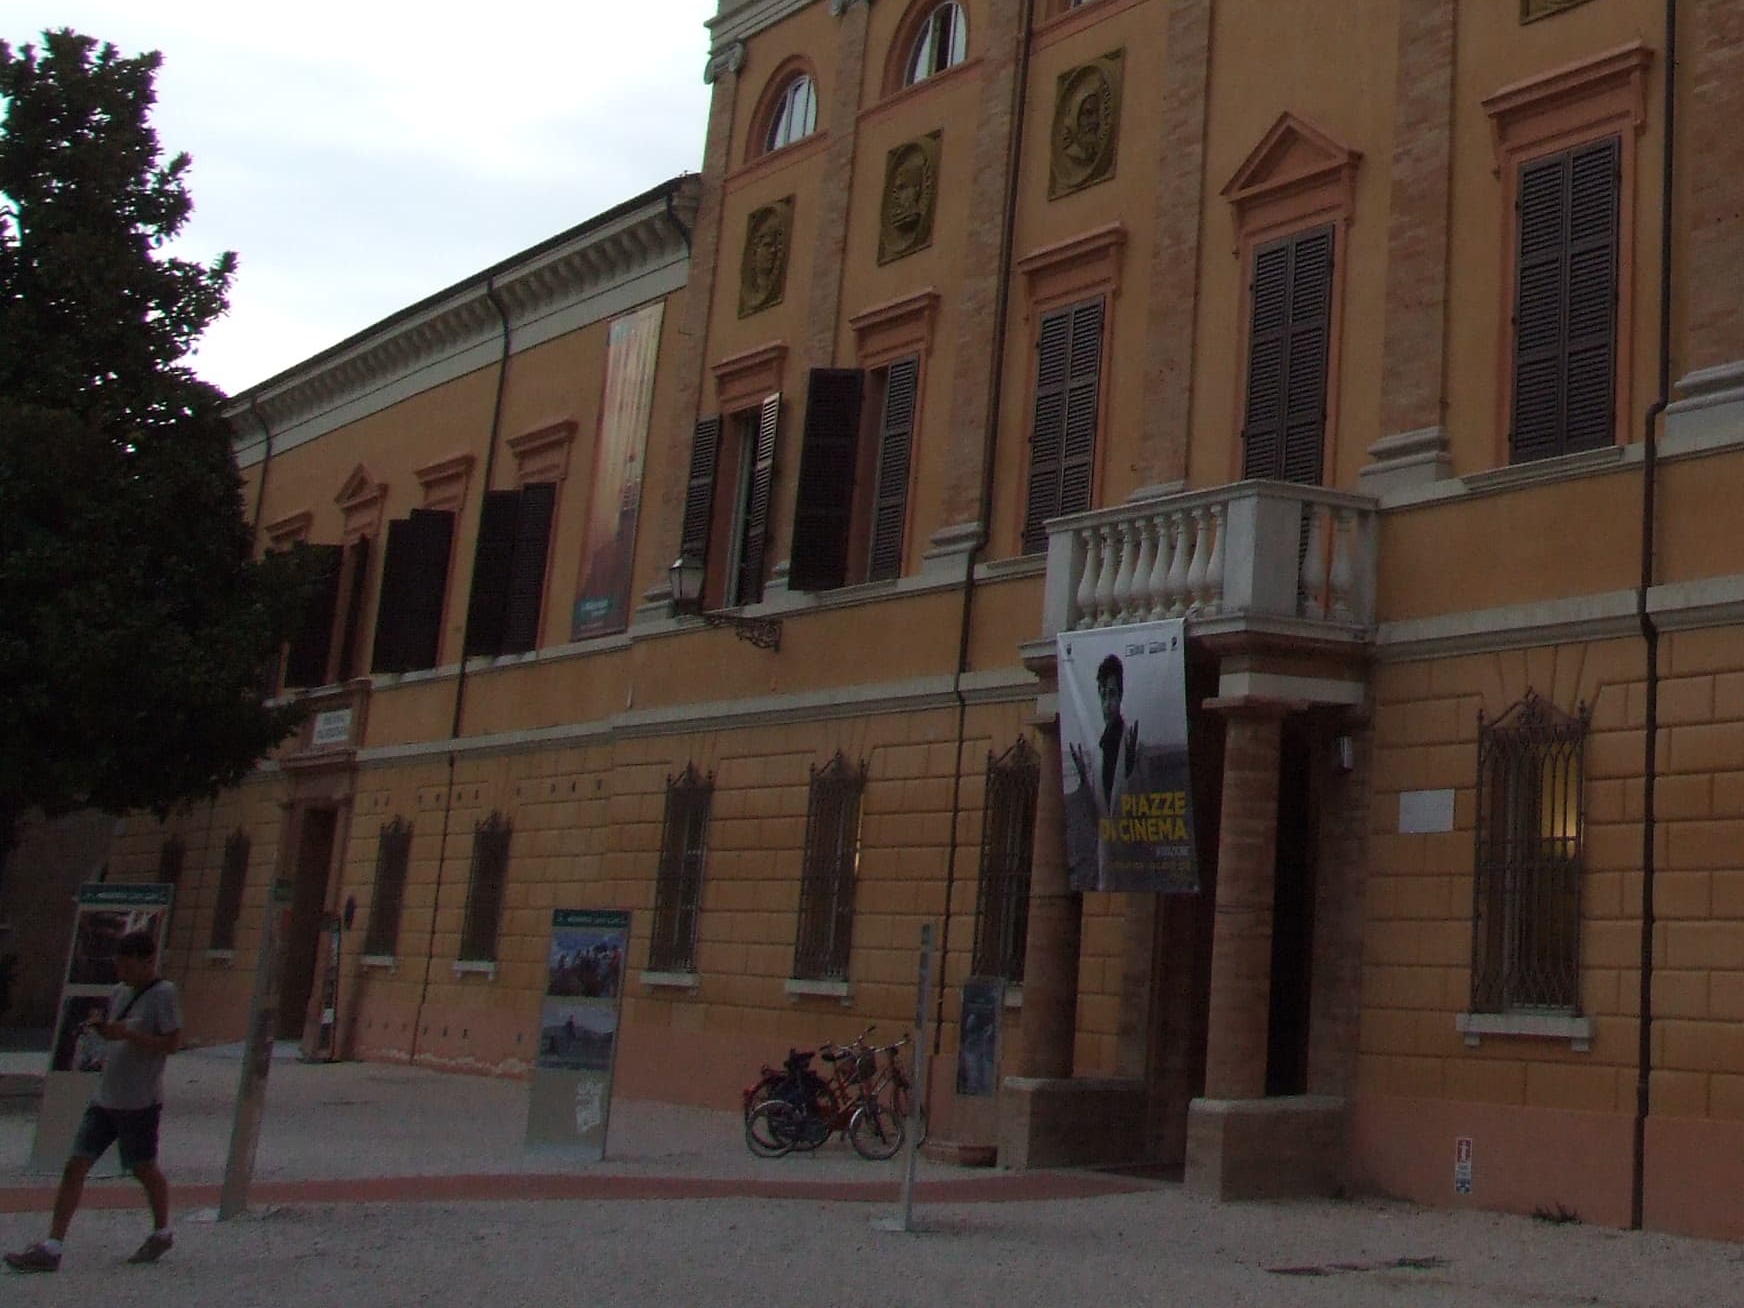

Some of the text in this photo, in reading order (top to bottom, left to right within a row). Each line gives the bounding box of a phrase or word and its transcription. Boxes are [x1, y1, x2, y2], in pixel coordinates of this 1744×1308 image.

[1120, 791, 1186, 816] PIAZZE
[1099, 817, 1187, 843] DI CINEMA
